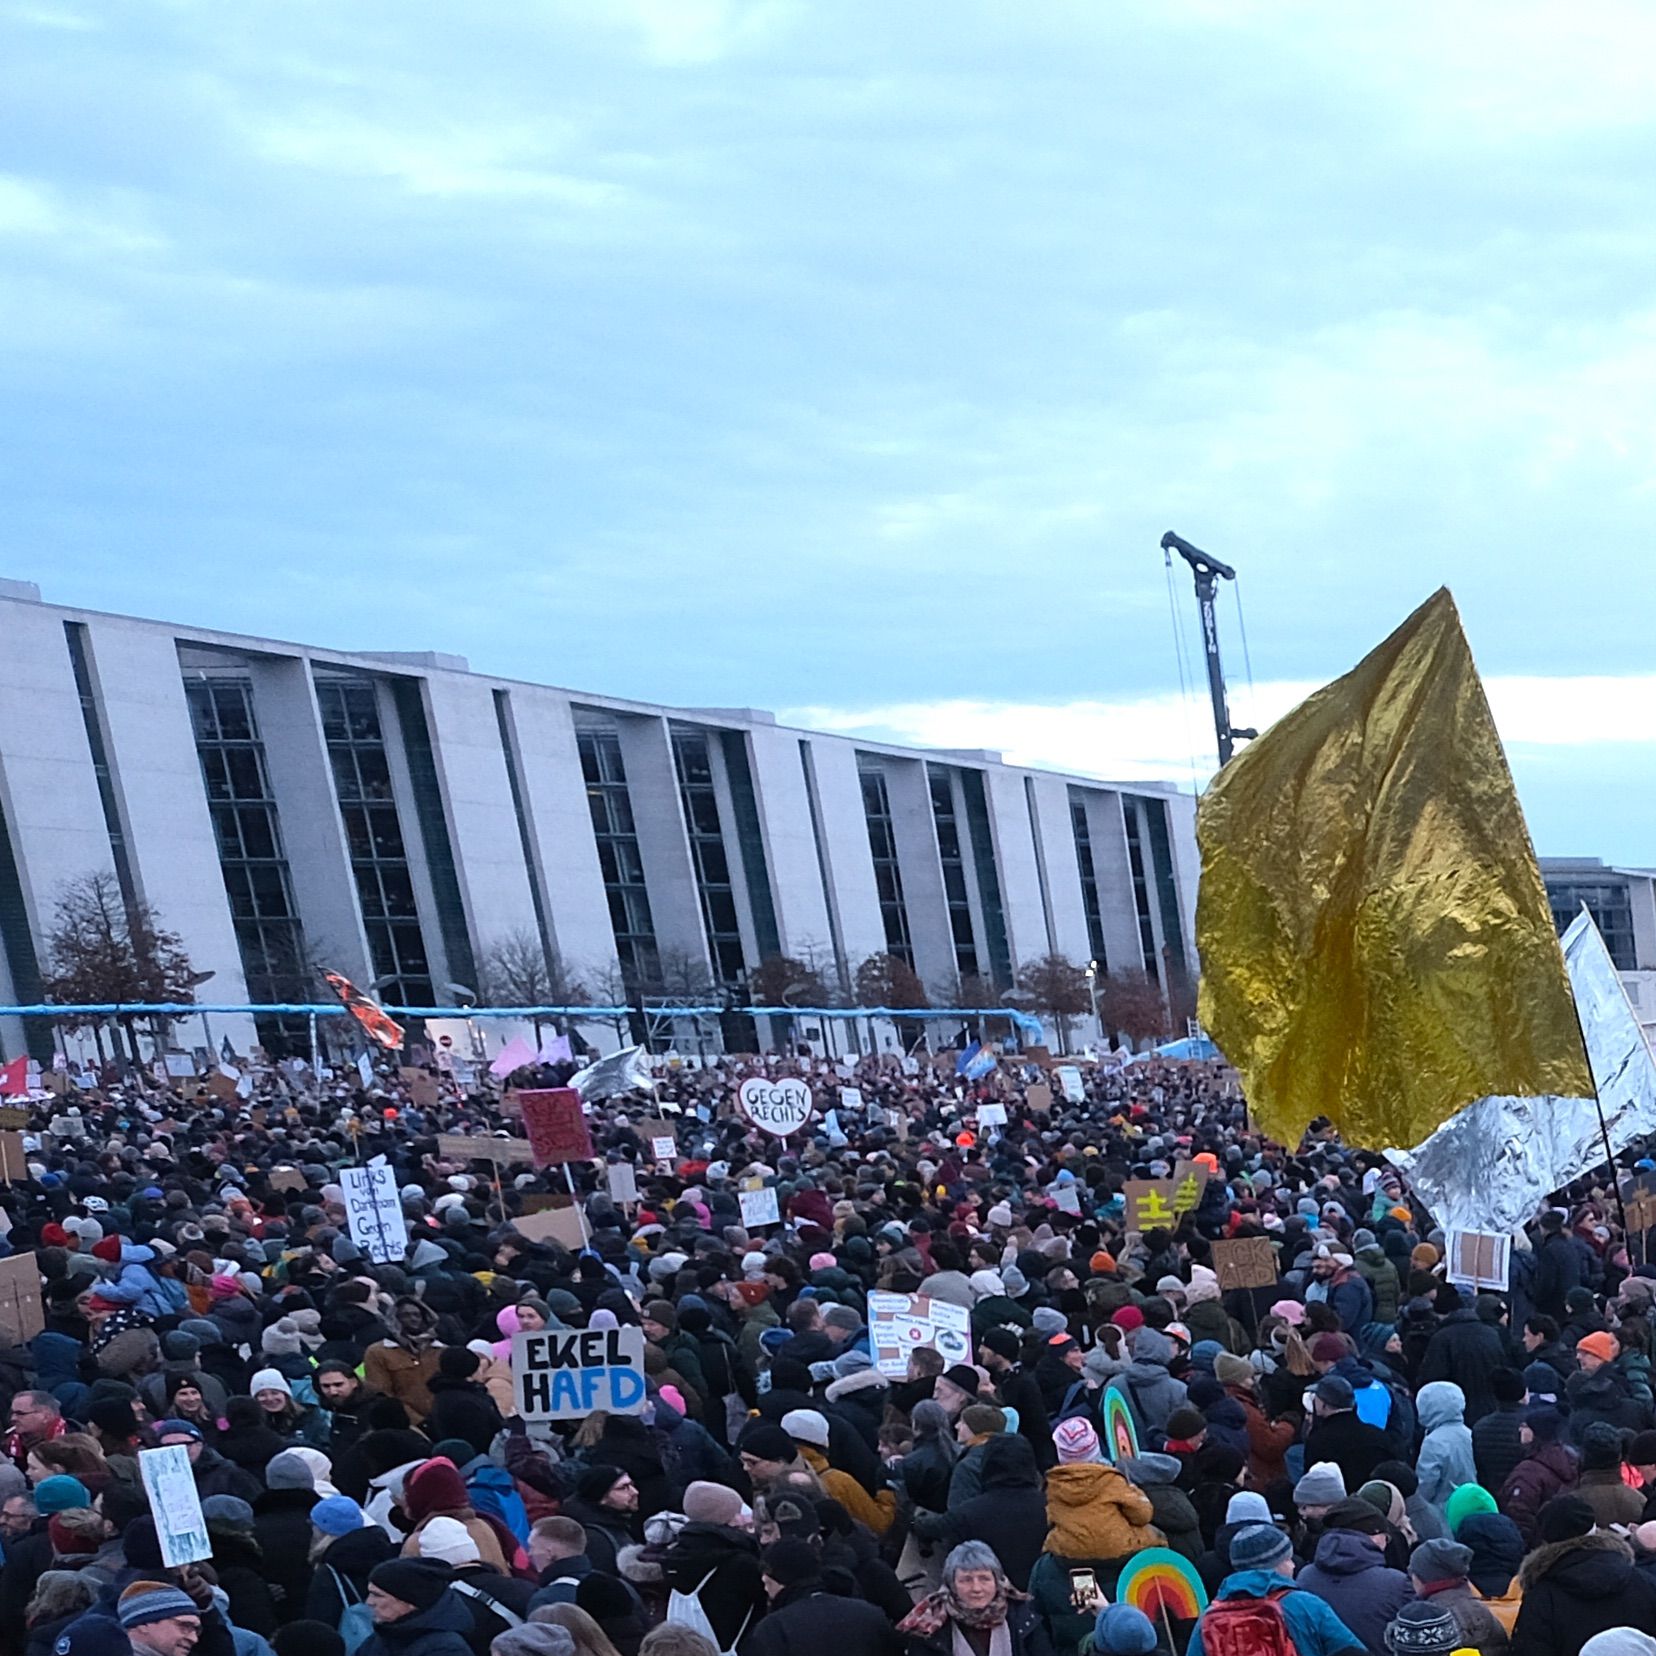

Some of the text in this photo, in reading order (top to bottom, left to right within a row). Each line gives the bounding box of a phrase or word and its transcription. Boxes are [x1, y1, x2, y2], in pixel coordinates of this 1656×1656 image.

[746, 1087, 808, 1106] GEGEN
[750, 1105, 806, 1123] RECHTS
[526, 1329, 632, 1370] EKEL
[522, 1366, 644, 1413] HAFD
